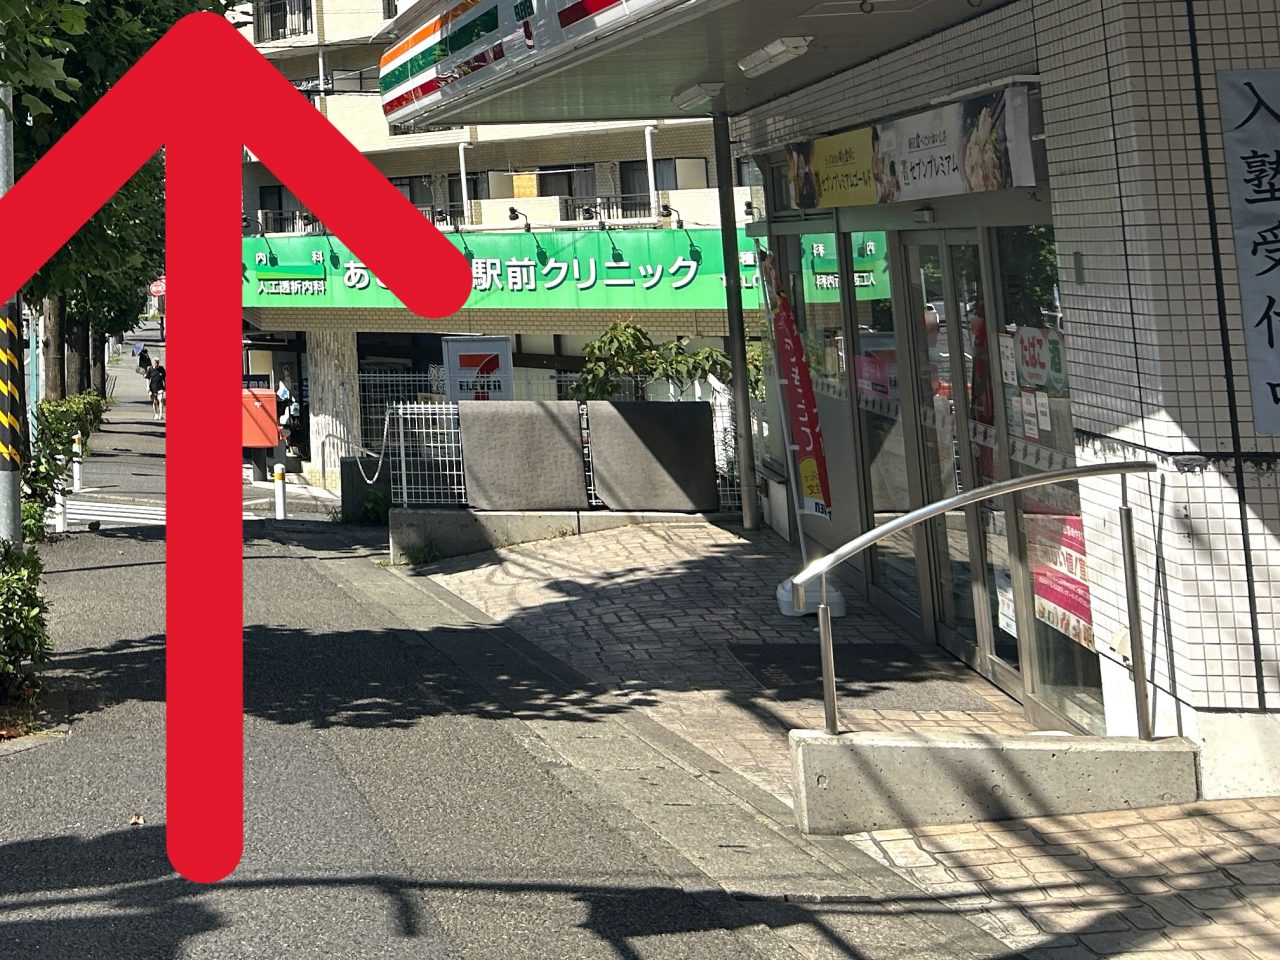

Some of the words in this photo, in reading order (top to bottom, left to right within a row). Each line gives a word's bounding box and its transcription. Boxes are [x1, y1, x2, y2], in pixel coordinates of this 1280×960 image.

[255, 252, 268, 265] 内
[311, 251, 324, 264] 科
[257, 280, 326, 296] 人工透析内科
